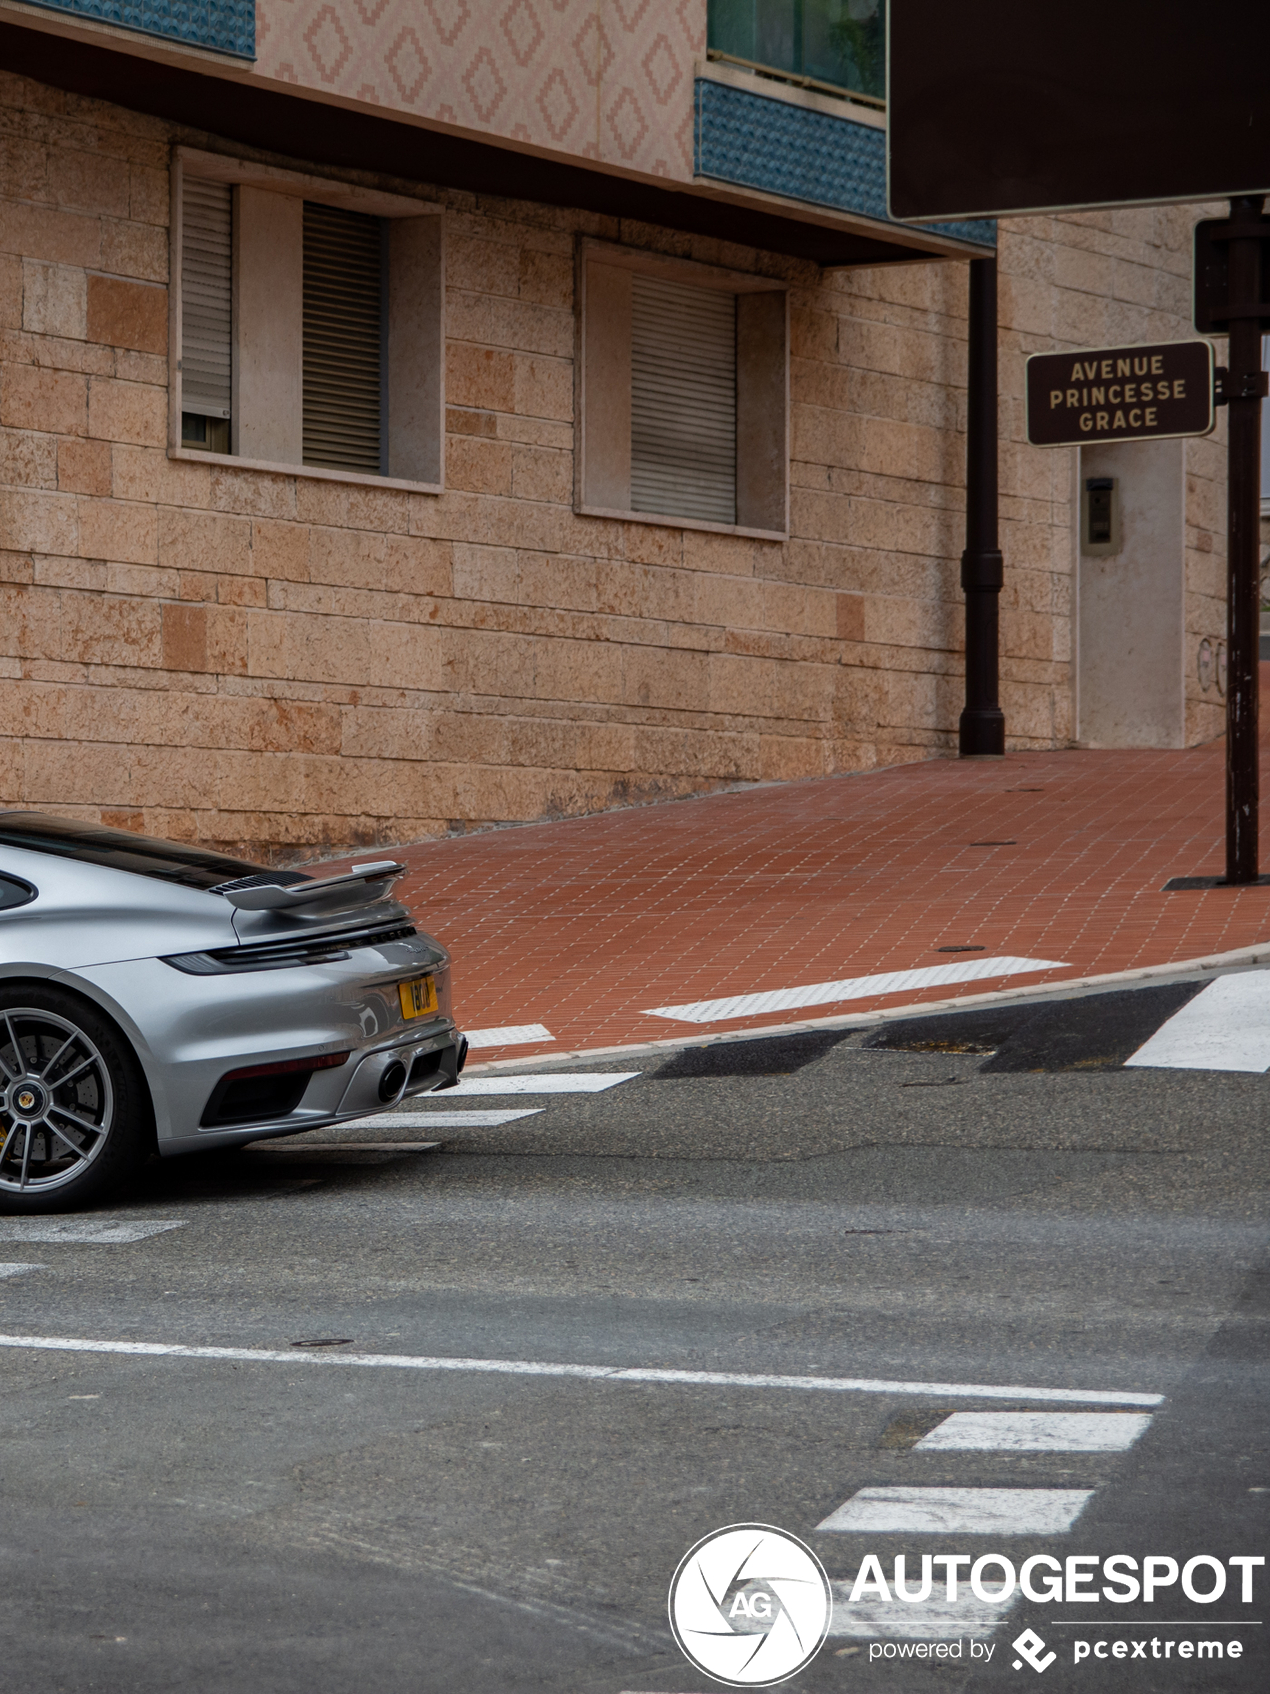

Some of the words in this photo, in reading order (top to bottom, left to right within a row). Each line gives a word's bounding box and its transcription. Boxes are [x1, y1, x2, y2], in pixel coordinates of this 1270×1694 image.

[1070, 354, 1164, 382] AVENUE
[1049, 379, 1186, 410] PRINCESSE
[1079, 407, 1158, 432] GRACE
